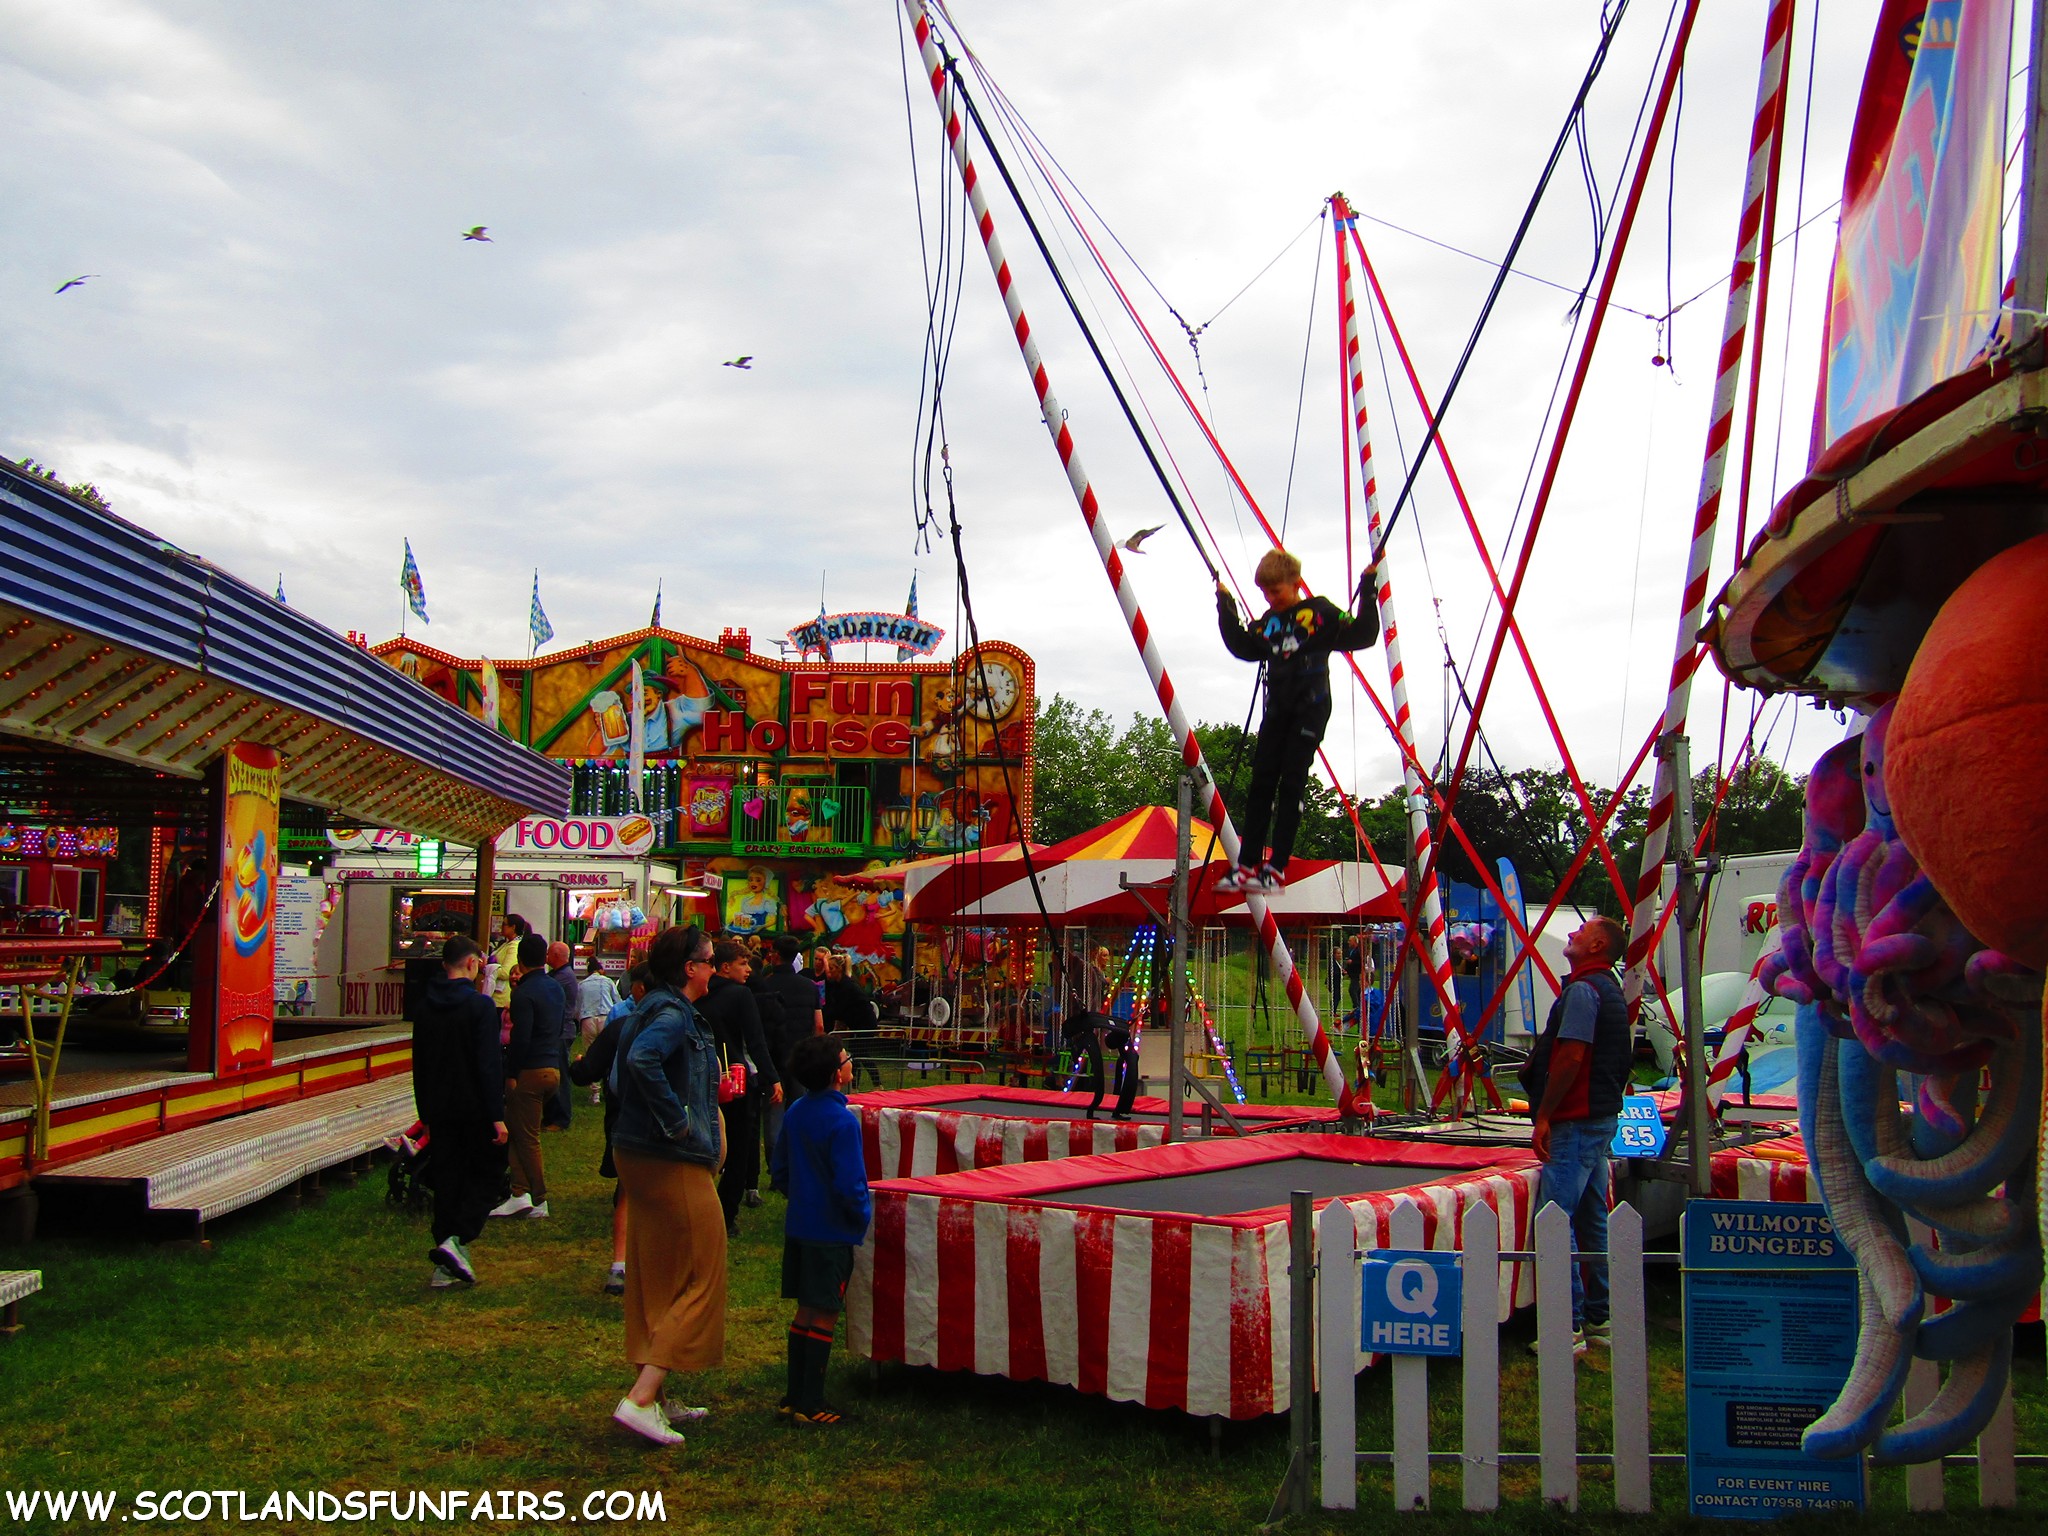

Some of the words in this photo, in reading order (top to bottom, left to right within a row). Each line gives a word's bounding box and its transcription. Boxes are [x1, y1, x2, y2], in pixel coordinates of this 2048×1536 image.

[796, 618, 932, 650] Bavarian
[793, 672, 914, 716] Fun
[704, 711, 911, 754] House
[229, 754, 278, 805] SMITH'S
[516, 820, 614, 849] FOOD
[745, 844, 782, 854] CRAZY
[790, 845, 810, 854] CAR
[813, 846, 846, 854] WASH
[559, 874, 608, 886] DRINKS
[346, 982, 370, 1014] BUY
[1622, 1126, 1656, 1146] £5
[1710, 1212, 1834, 1234] WILMOTS
[1709, 1235, 1834, 1256] BUNGEES
[1386, 1258, 1438, 1318] Q
[1372, 1321, 1450, 1346] HERE
[1717, 1478, 1744, 1489] FOR
[1749, 1479, 1794, 1491] EVENT
[1798, 1481, 1831, 1492] HIRE
[1695, 1494, 1758, 1507] CONTACT
[1762, 1497, 1802, 1509] 07958
